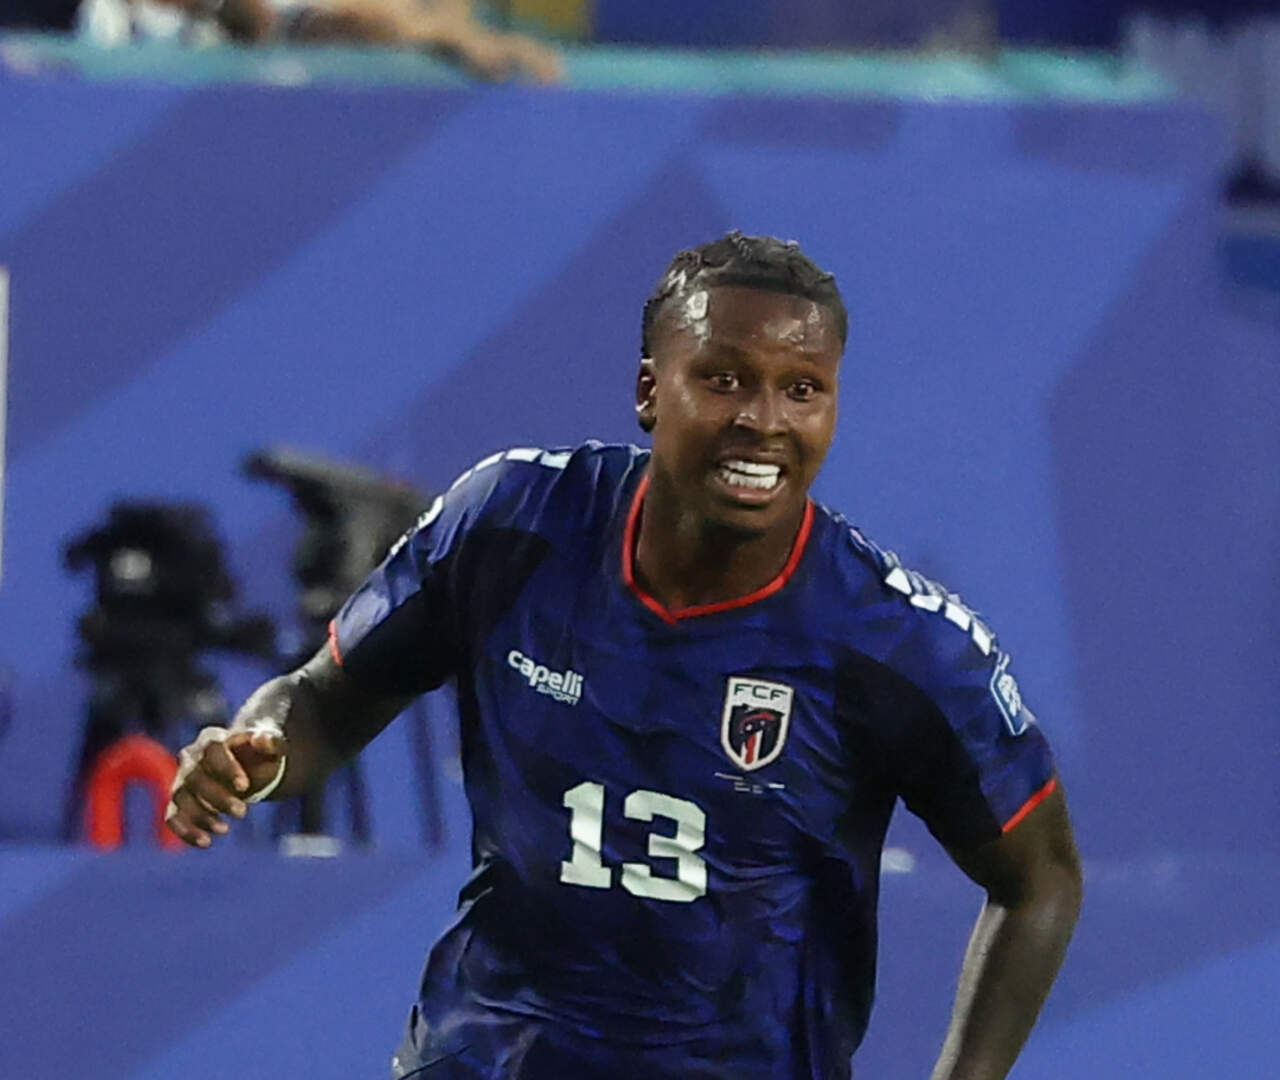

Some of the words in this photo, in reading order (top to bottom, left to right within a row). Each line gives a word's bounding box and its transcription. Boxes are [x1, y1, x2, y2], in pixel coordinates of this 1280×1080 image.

[507, 649, 584, 699] capelli
[733, 683, 788, 701] FCF
[560, 781, 707, 903] 13
